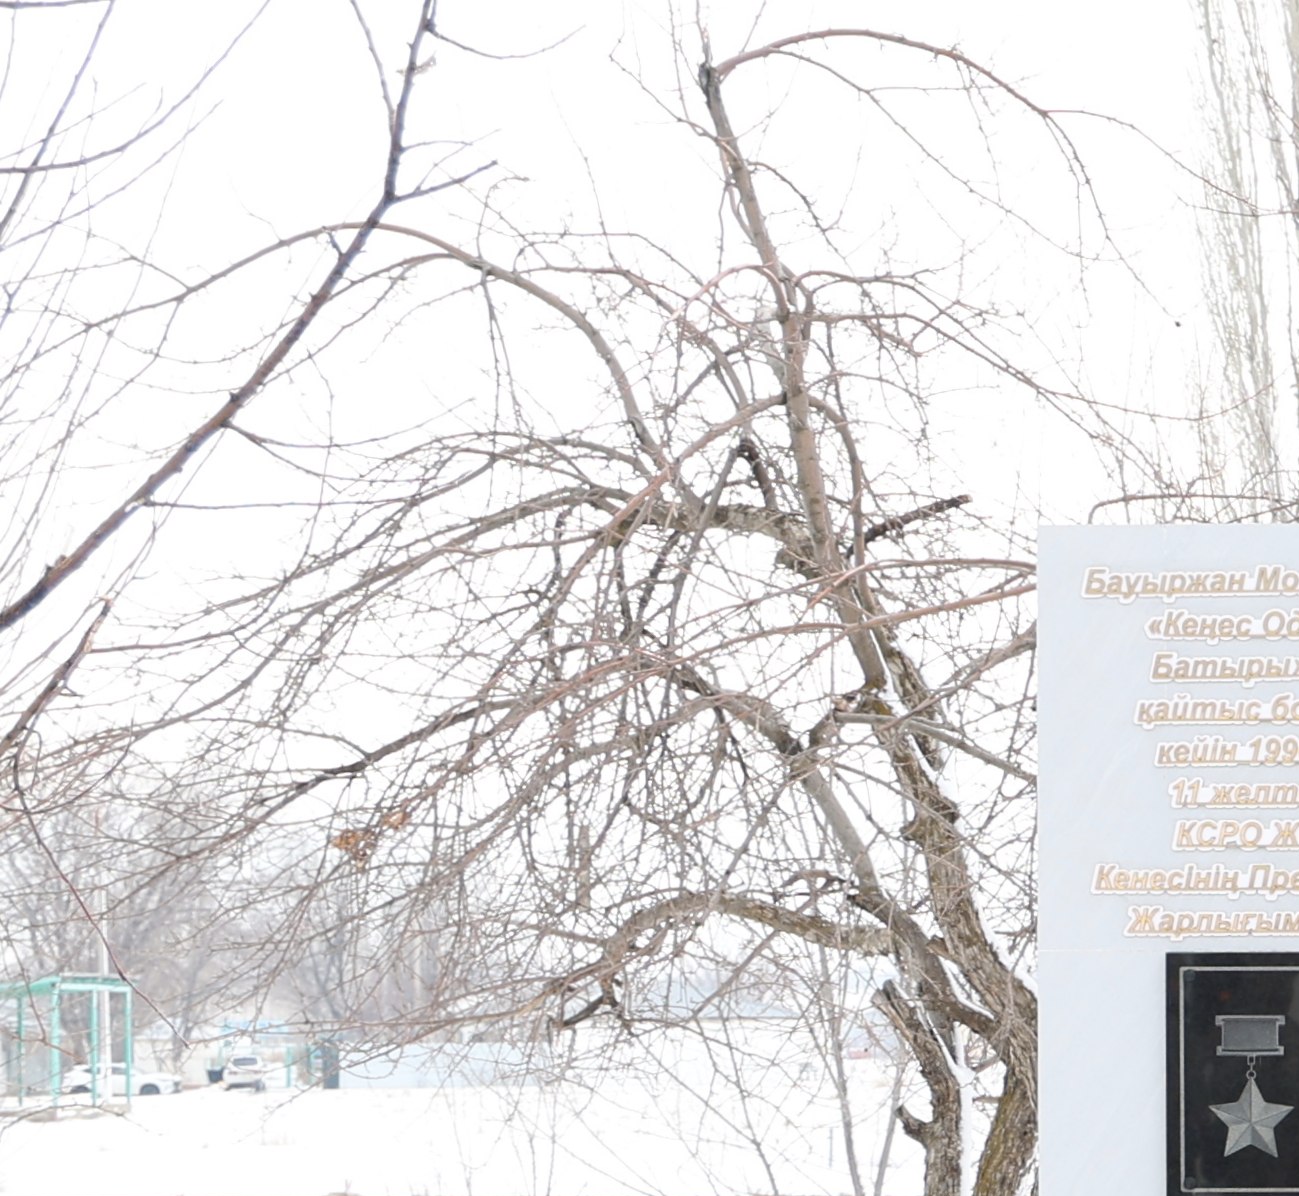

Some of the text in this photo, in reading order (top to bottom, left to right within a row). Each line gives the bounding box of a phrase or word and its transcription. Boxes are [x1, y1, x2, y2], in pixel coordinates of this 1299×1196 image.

[1083, 567, 1245, 600] Бауыржан
[1148, 612, 1252, 641] «Кеңес
[1137, 695, 1261, 723] қайтыс
[1157, 737, 1237, 763] кейін
[1170, 779, 1201, 807] 11
[1176, 821, 1264, 847] КСРО
